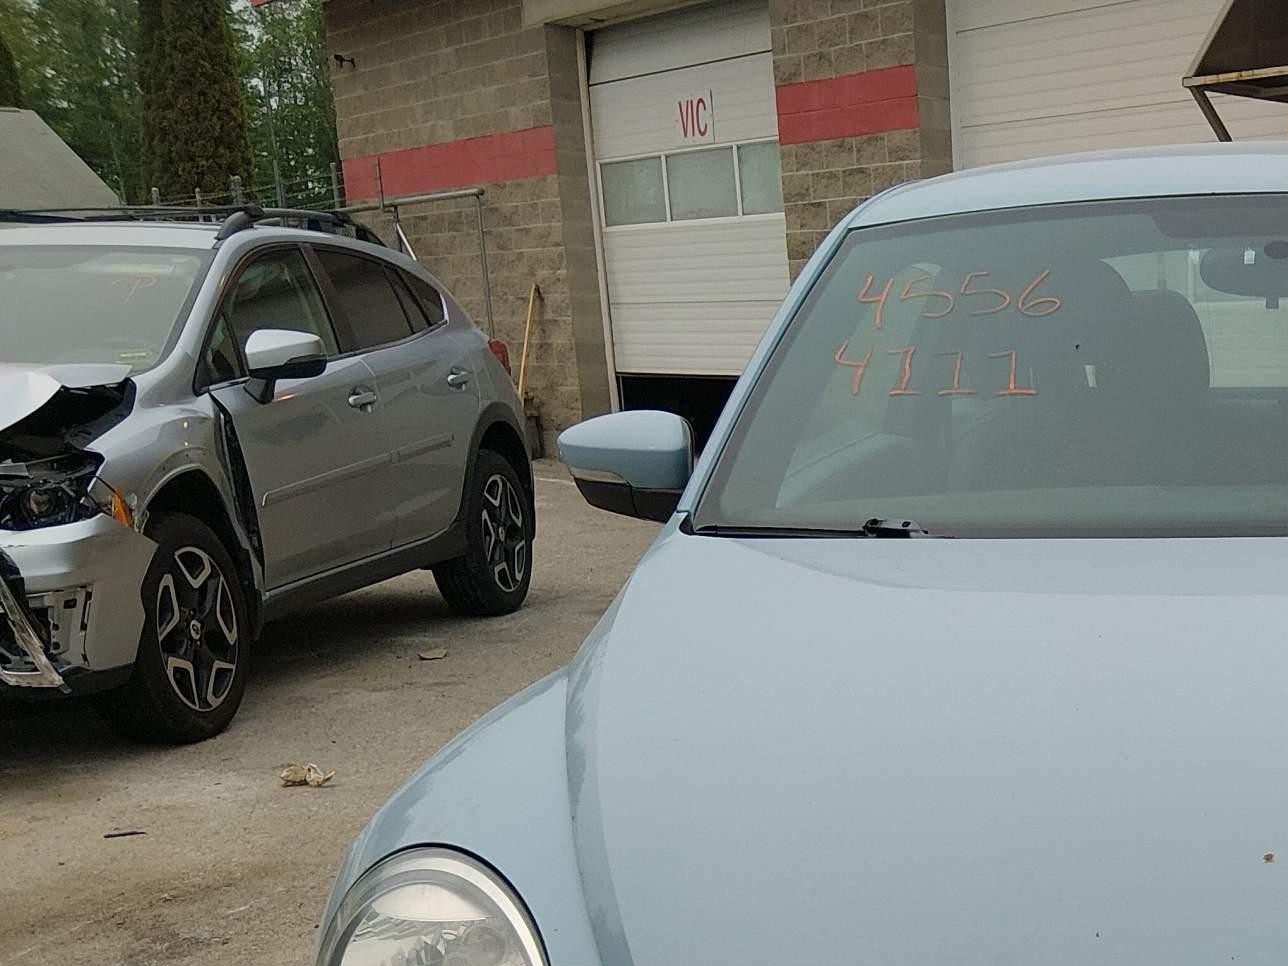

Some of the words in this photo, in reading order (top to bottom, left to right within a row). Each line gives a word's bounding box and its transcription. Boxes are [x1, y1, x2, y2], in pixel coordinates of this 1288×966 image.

[678, 97, 708, 138] VIC
[857, 269, 1062, 330] 4556
[834, 340, 1040, 396] 4111
